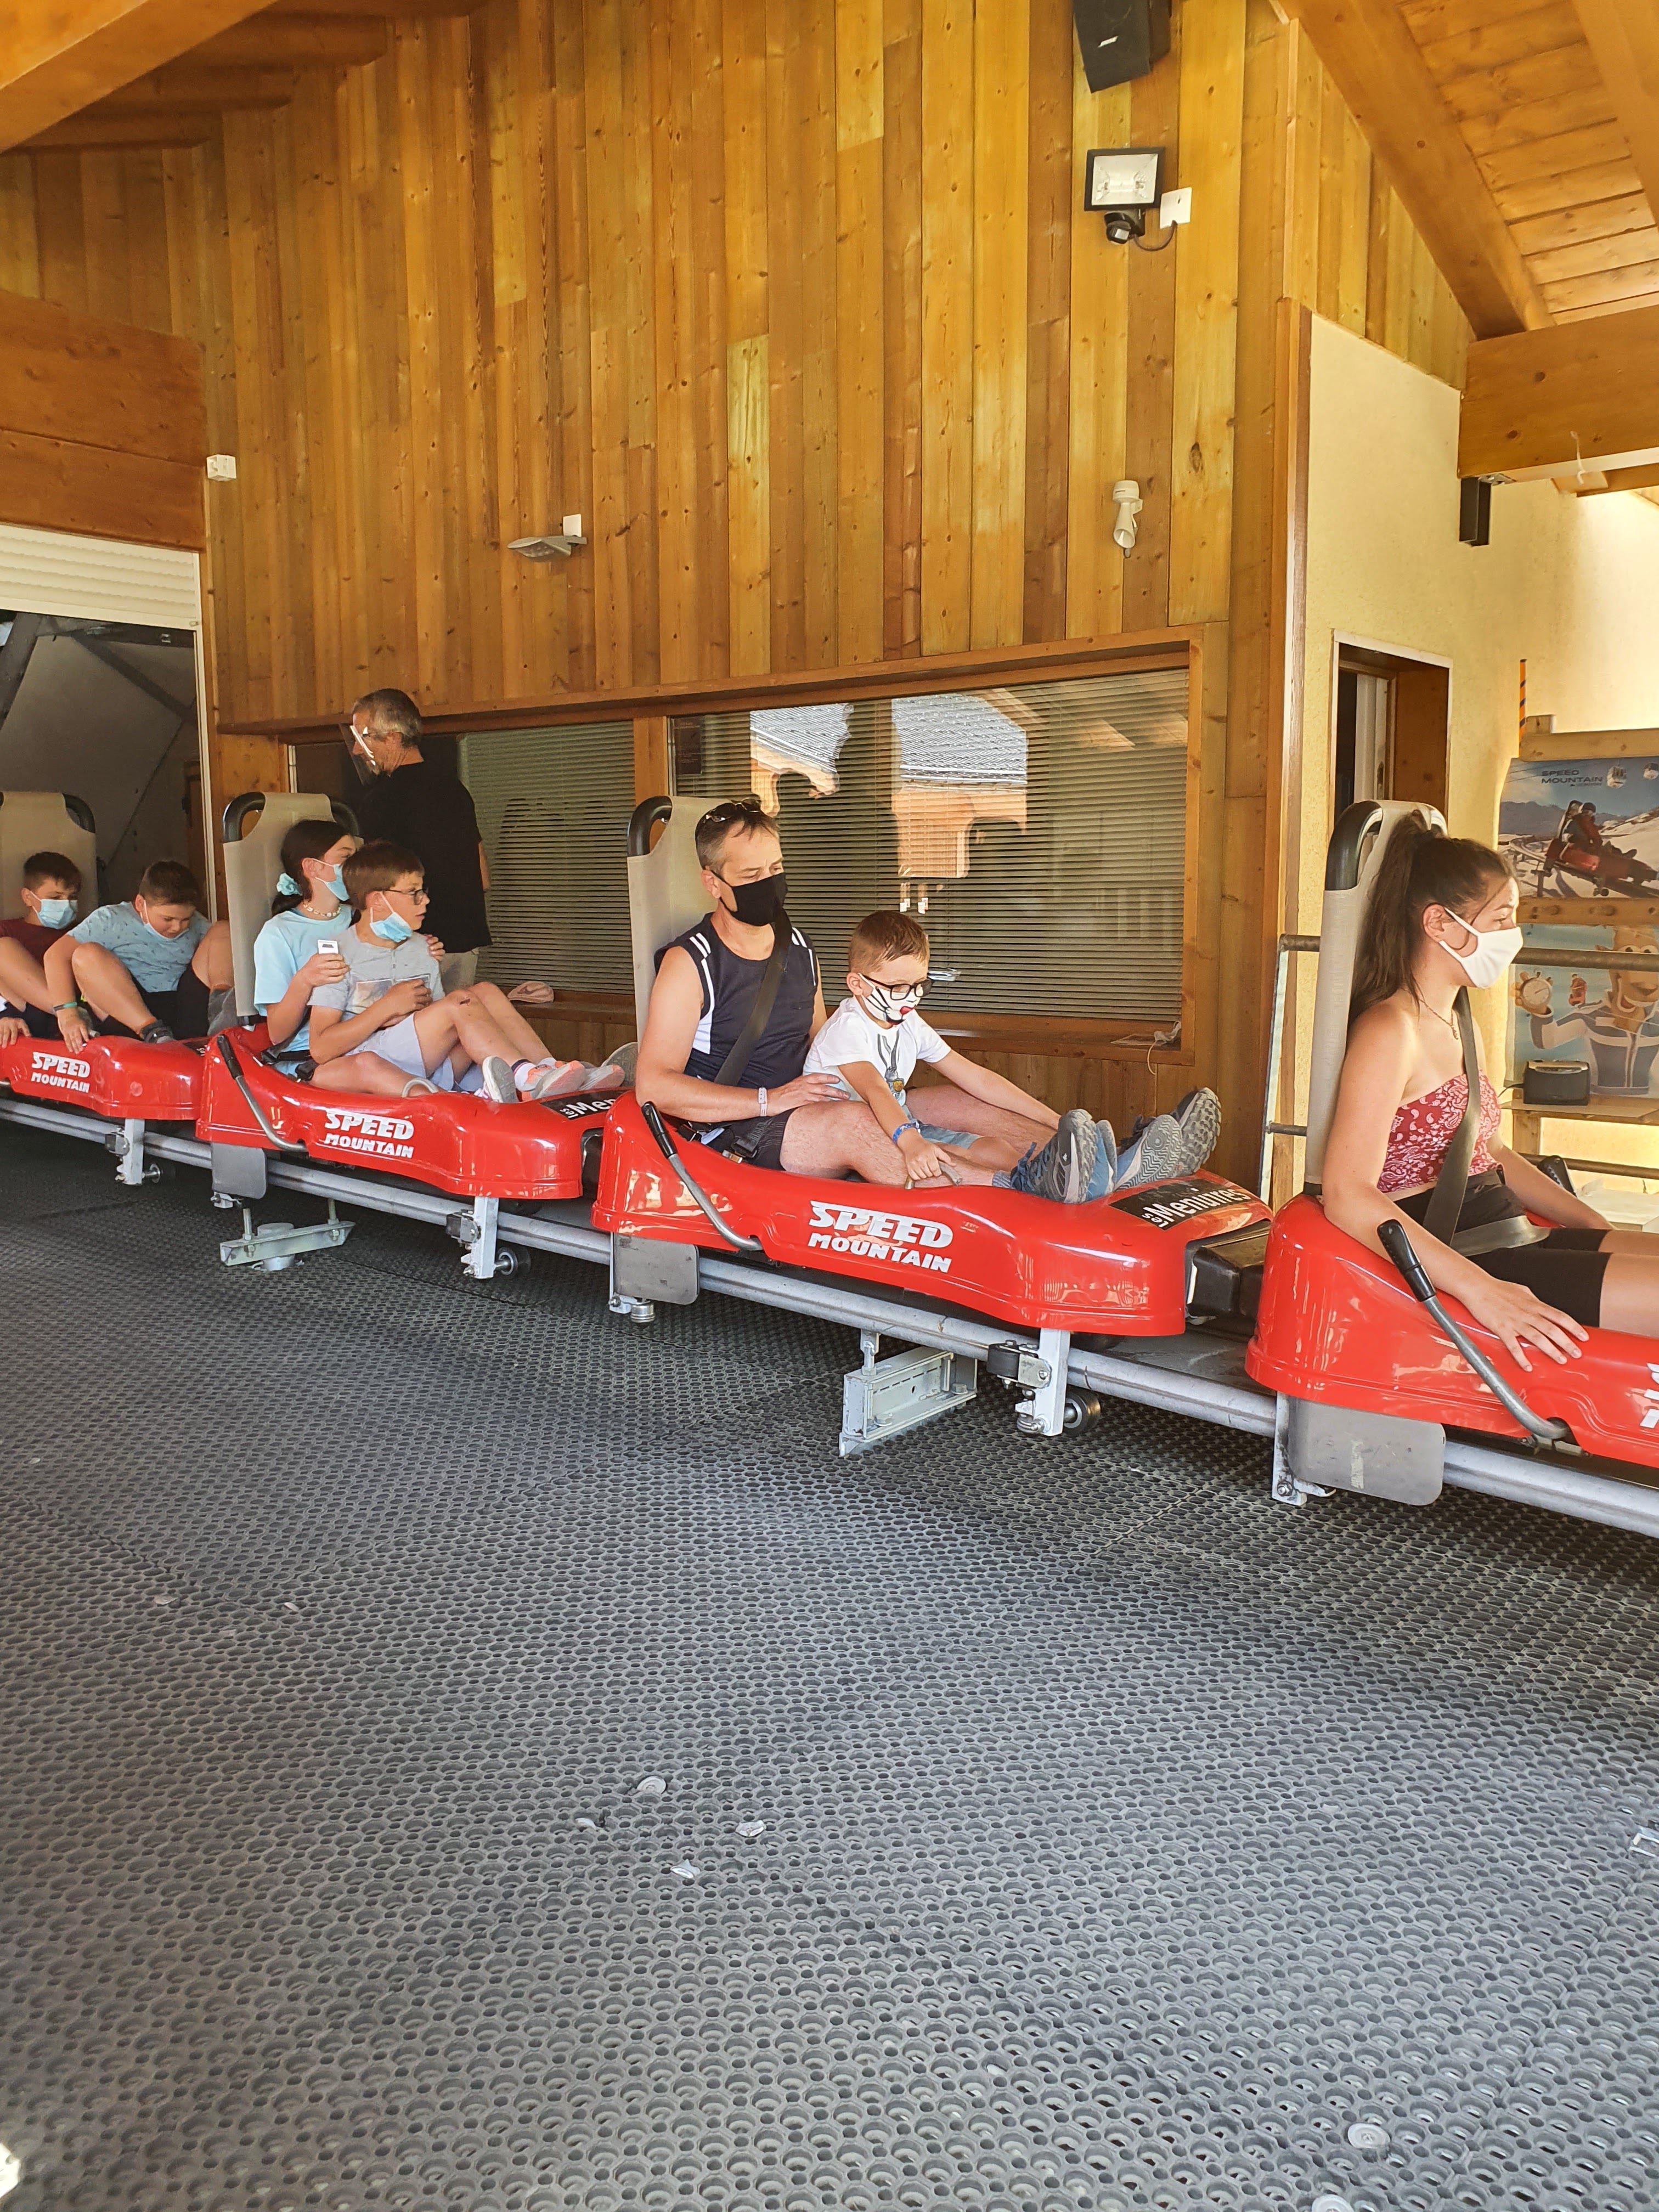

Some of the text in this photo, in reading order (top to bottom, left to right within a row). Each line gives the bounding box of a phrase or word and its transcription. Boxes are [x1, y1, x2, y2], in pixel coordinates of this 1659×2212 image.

[31, 1051, 91, 1077] SPEED
[31, 1071, 90, 1093] MOUNTAIN
[325, 1109, 414, 1139] SPEED
[324, 1133, 414, 1158] MOUNTAIN
[1143, 1188, 1251, 1223] Menuires
[809, 1200, 953, 1248] SPEED
[808, 1233, 952, 1273] MOUNTAIN
